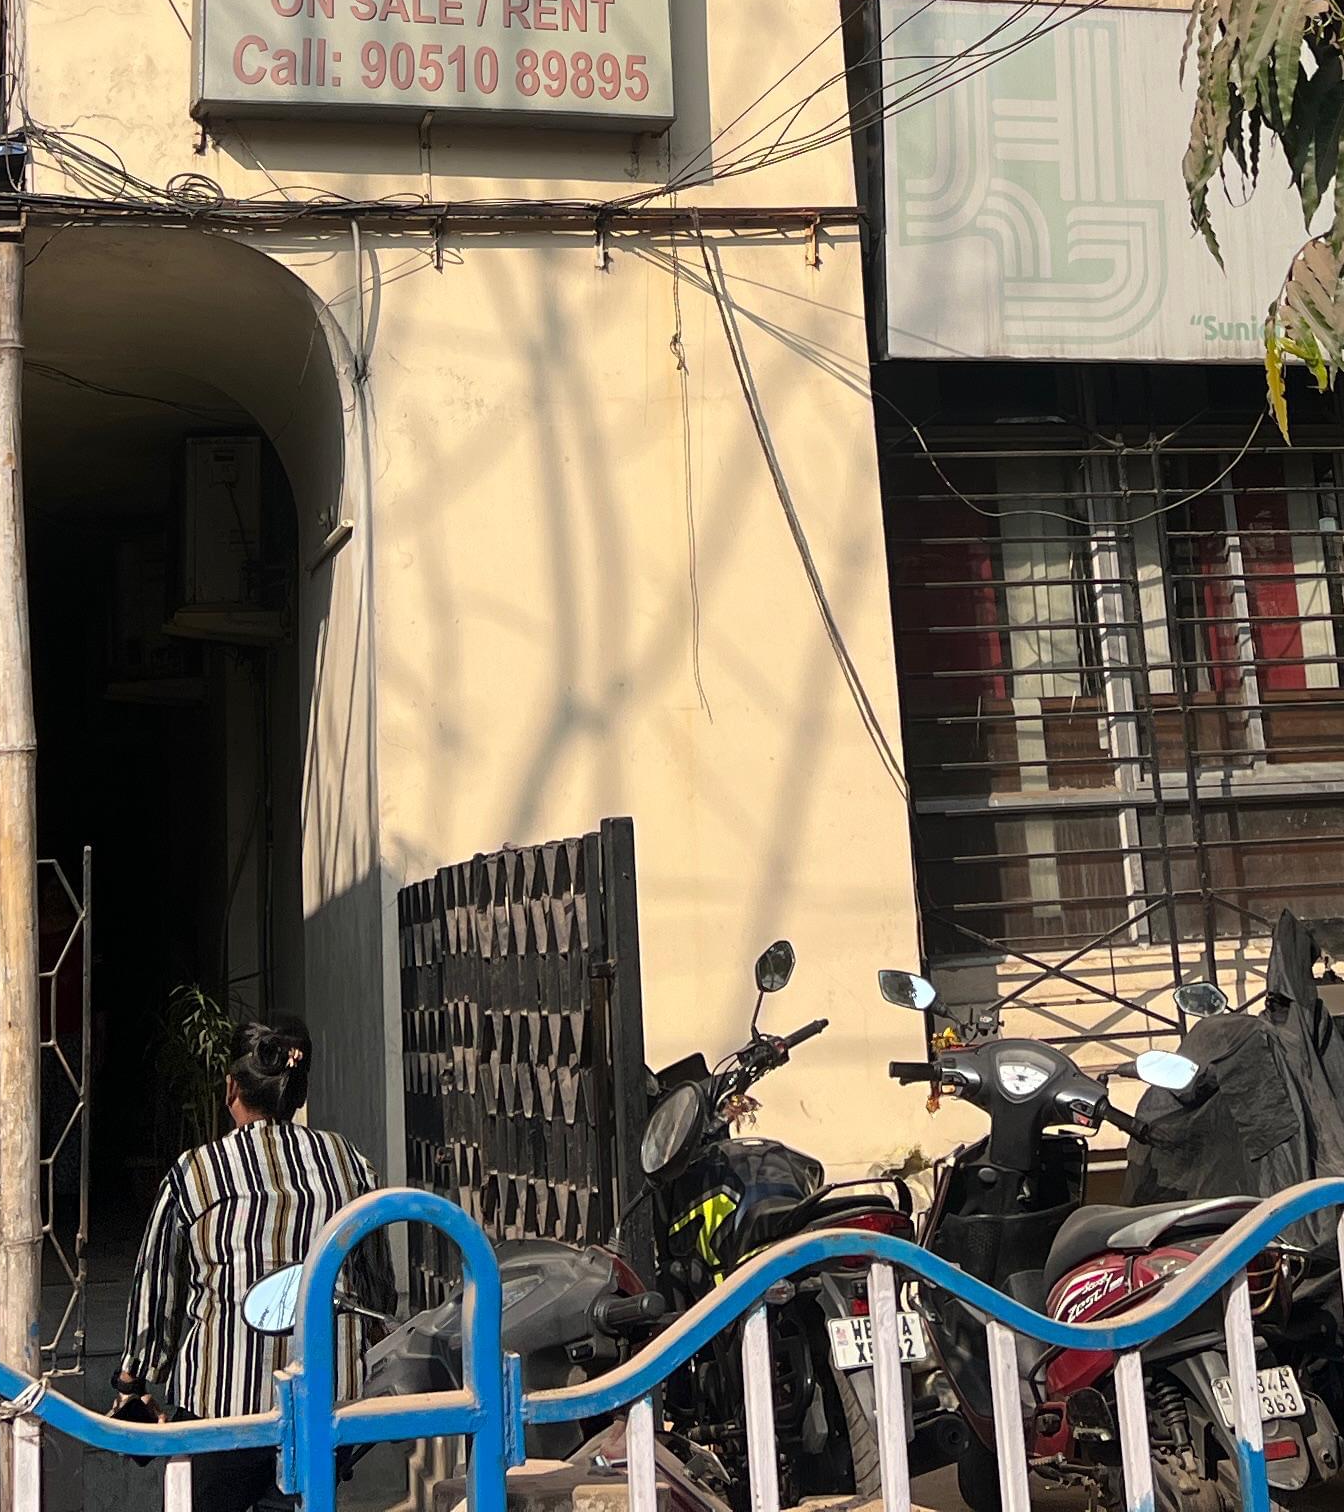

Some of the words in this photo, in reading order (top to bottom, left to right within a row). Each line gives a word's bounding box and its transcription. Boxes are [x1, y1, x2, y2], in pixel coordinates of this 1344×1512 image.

[232, 34, 342, 87] Call:
[361, 40, 499, 95] 90510
[515, 48, 650, 102] 89895
